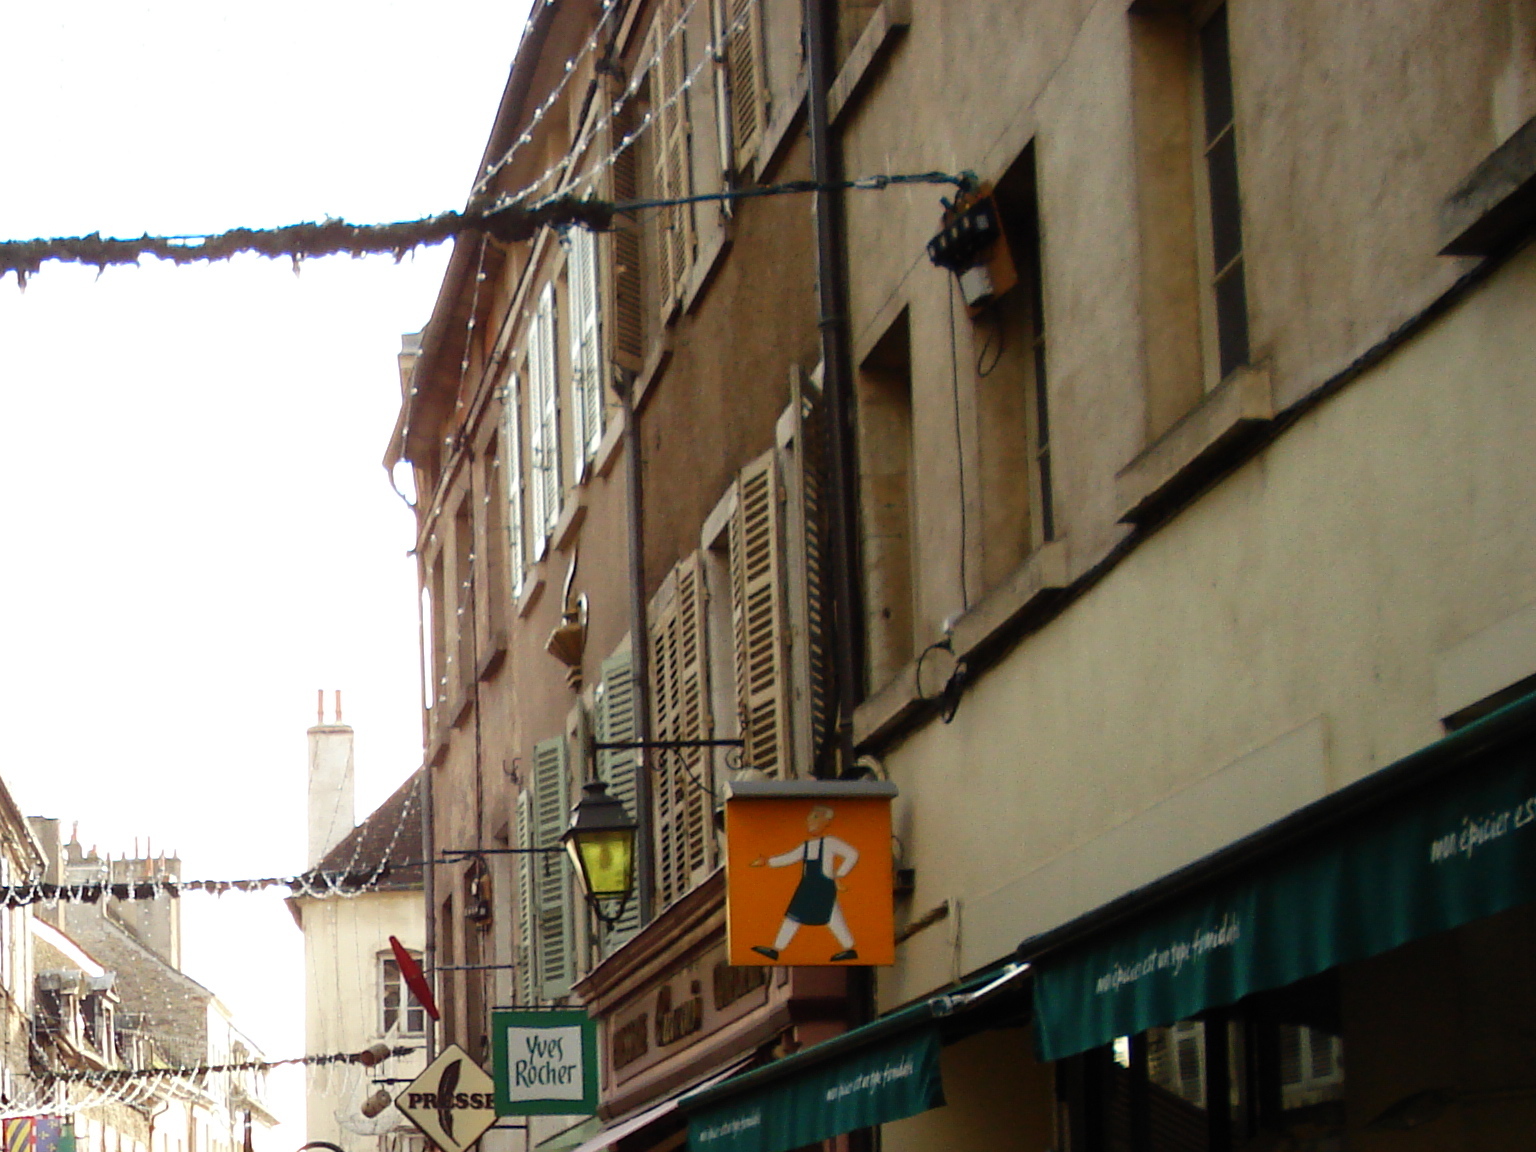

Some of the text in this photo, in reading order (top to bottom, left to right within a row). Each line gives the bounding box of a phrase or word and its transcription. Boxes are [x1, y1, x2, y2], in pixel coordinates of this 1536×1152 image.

[1514, 796, 1536, 829] es
[526, 1034, 563, 1063] Yves
[515, 1060, 576, 1088] Rocher
